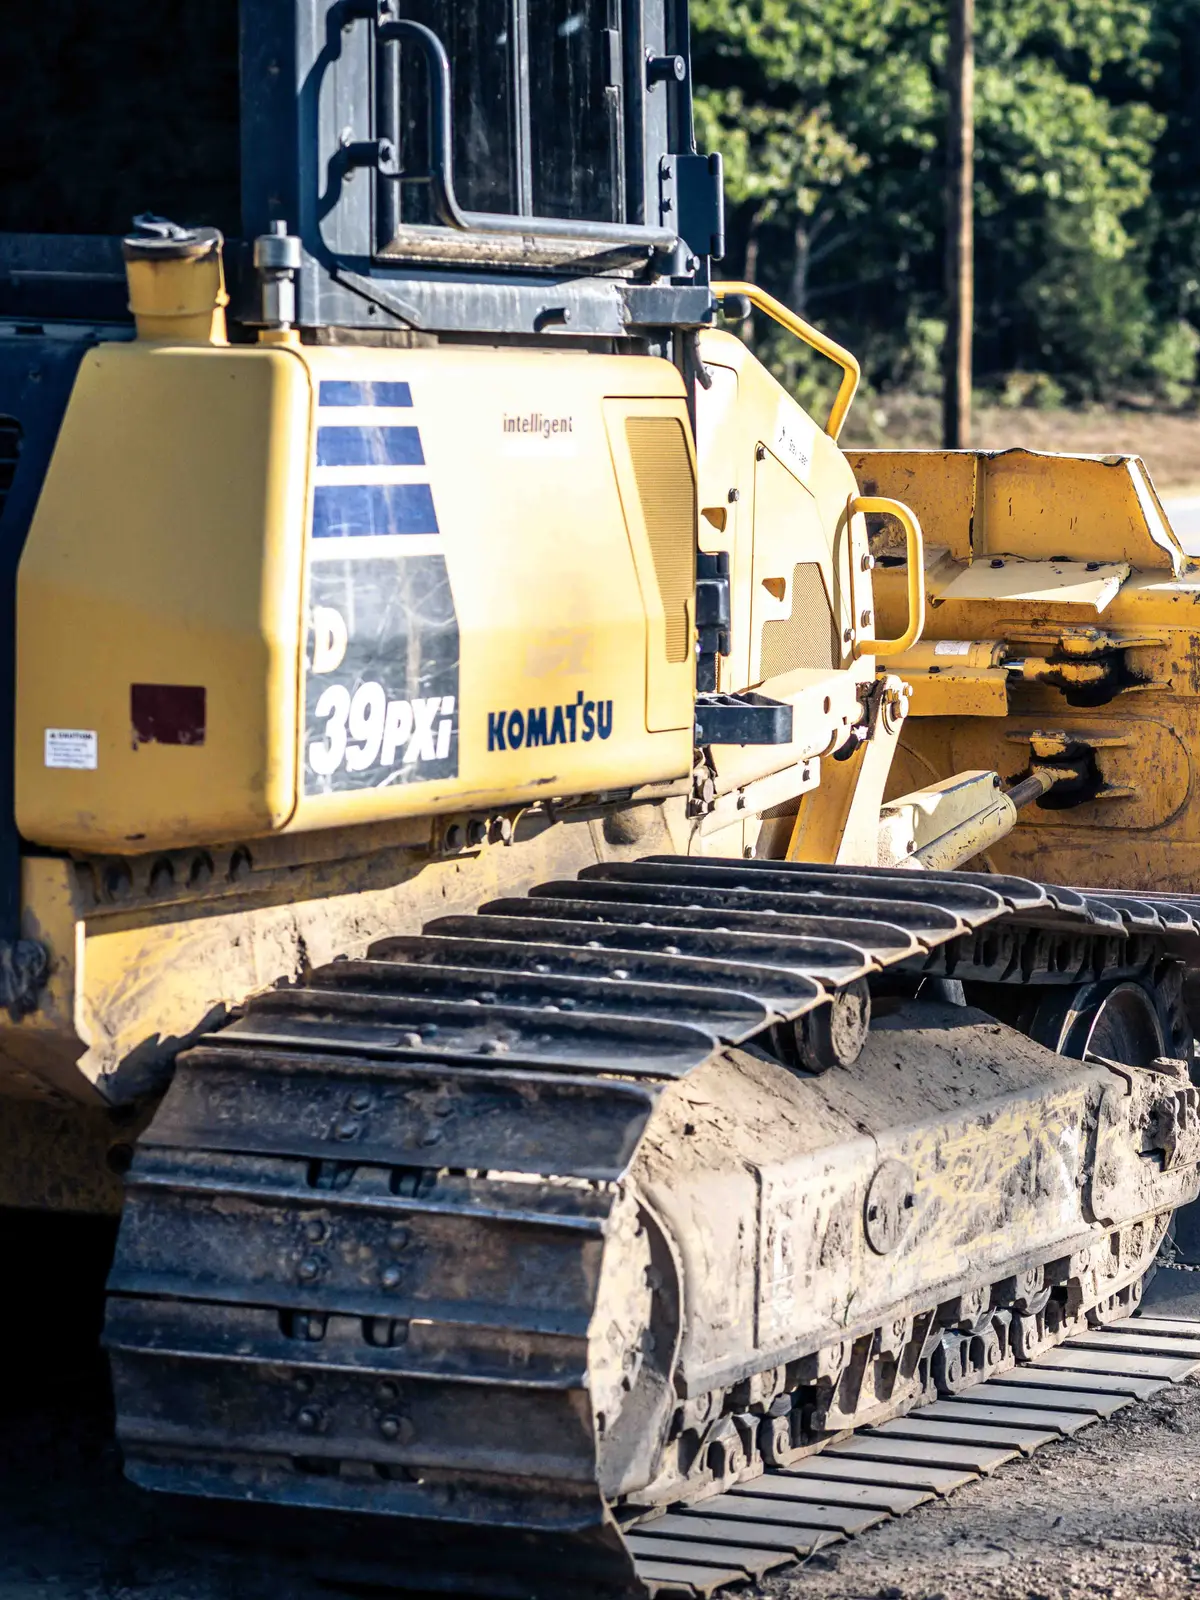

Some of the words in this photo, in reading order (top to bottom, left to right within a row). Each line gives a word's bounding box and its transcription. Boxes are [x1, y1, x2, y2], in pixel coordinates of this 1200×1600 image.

[503, 413, 572, 439] intelligent
[311, 606, 348, 674] D
[309, 681, 455, 775] 39PXi
[487, 690, 613, 752] KOMATSU
